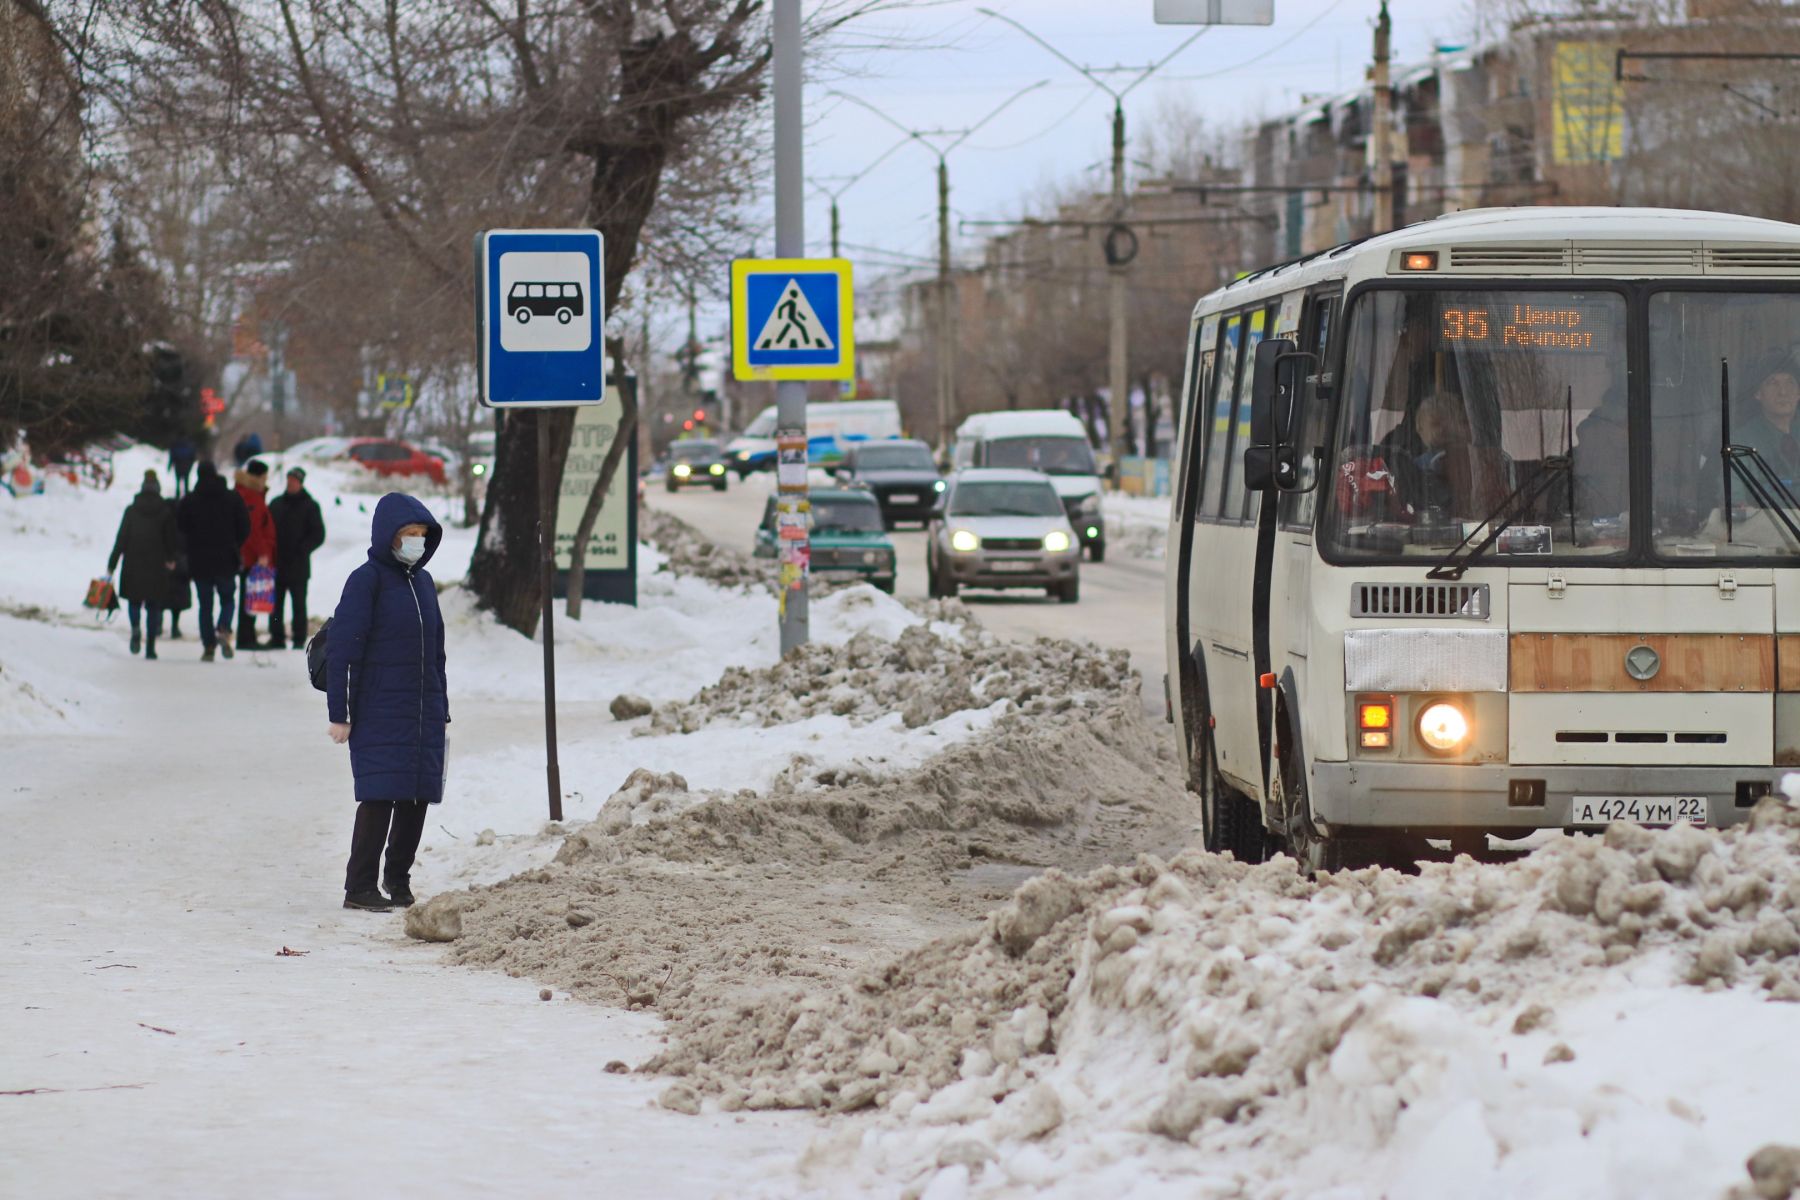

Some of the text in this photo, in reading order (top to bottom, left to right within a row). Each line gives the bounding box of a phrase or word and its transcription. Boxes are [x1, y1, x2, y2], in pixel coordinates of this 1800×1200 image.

[1443, 311, 1488, 338] 35
[1514, 304, 1580, 327] Центр
[1504, 325, 1592, 348] Речпорт
[1678, 798, 1700, 816] 22
